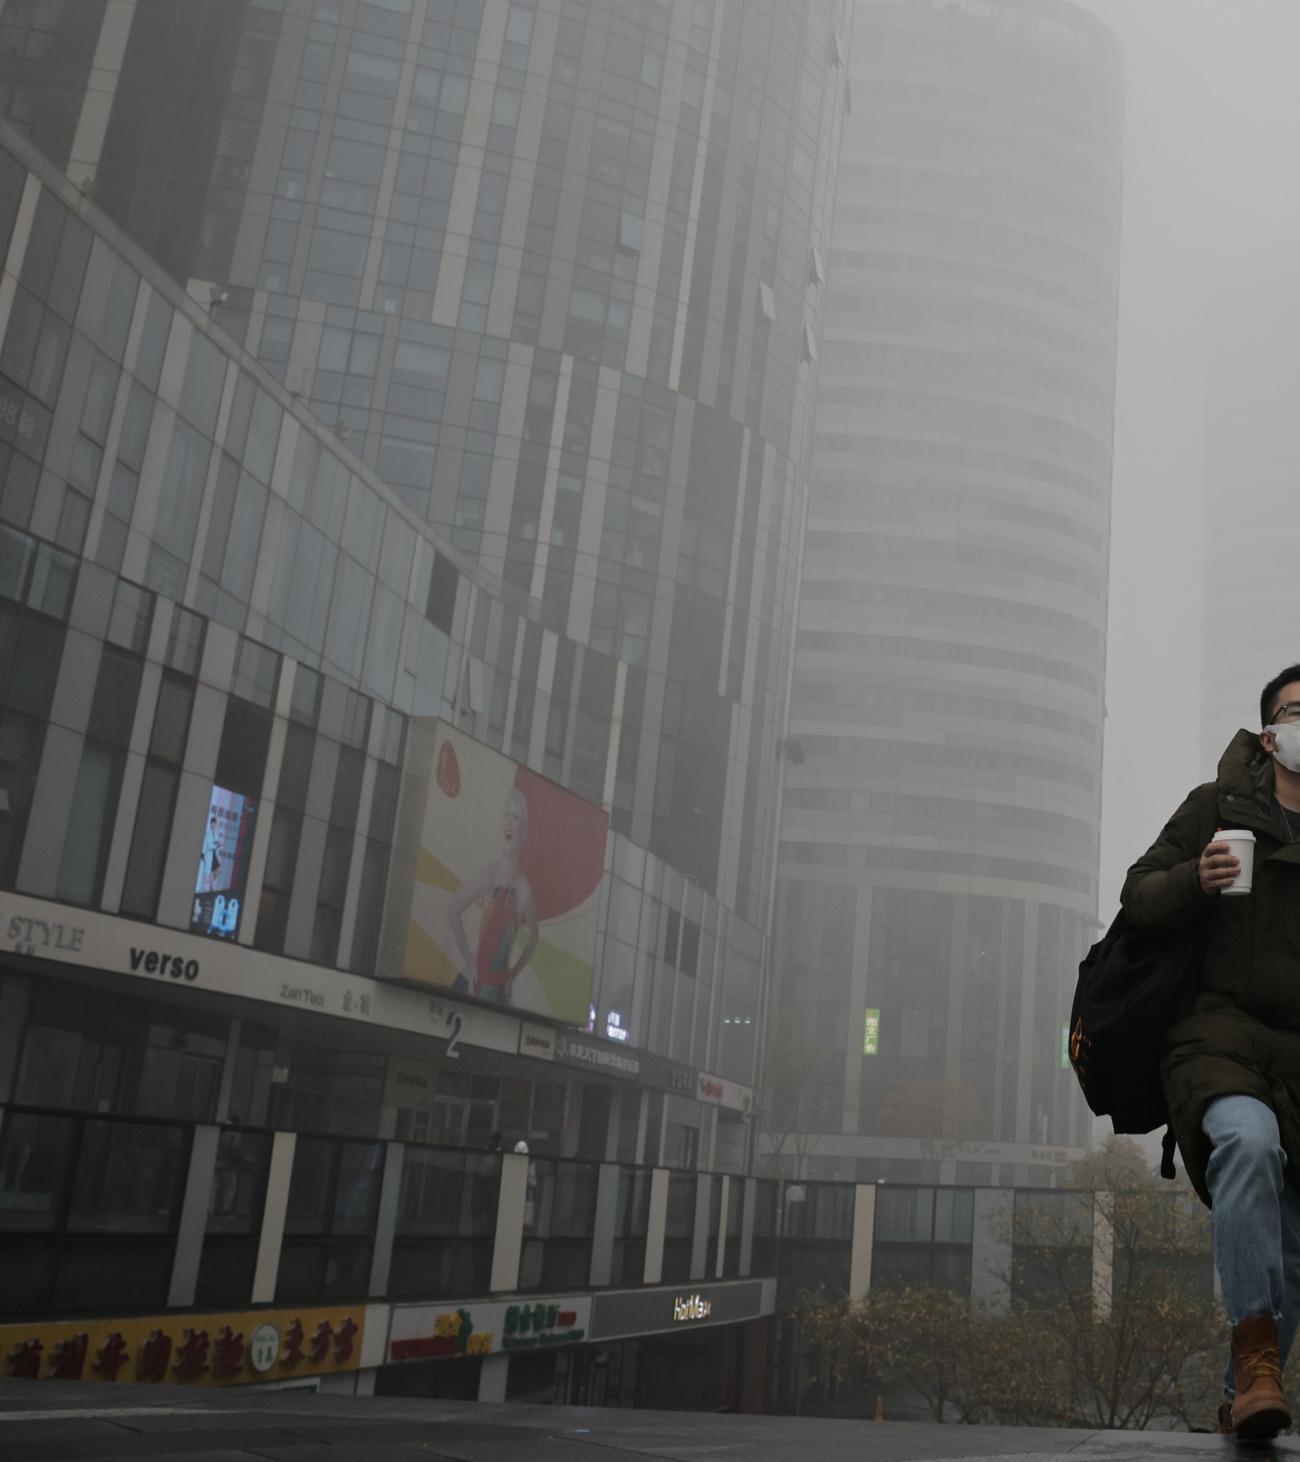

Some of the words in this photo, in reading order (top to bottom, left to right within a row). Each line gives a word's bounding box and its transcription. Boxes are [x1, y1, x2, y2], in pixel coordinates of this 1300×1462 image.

[7, 915, 85, 952] STYLE
[129, 947, 200, 980] verso
[446, 1011, 462, 1059] 2
